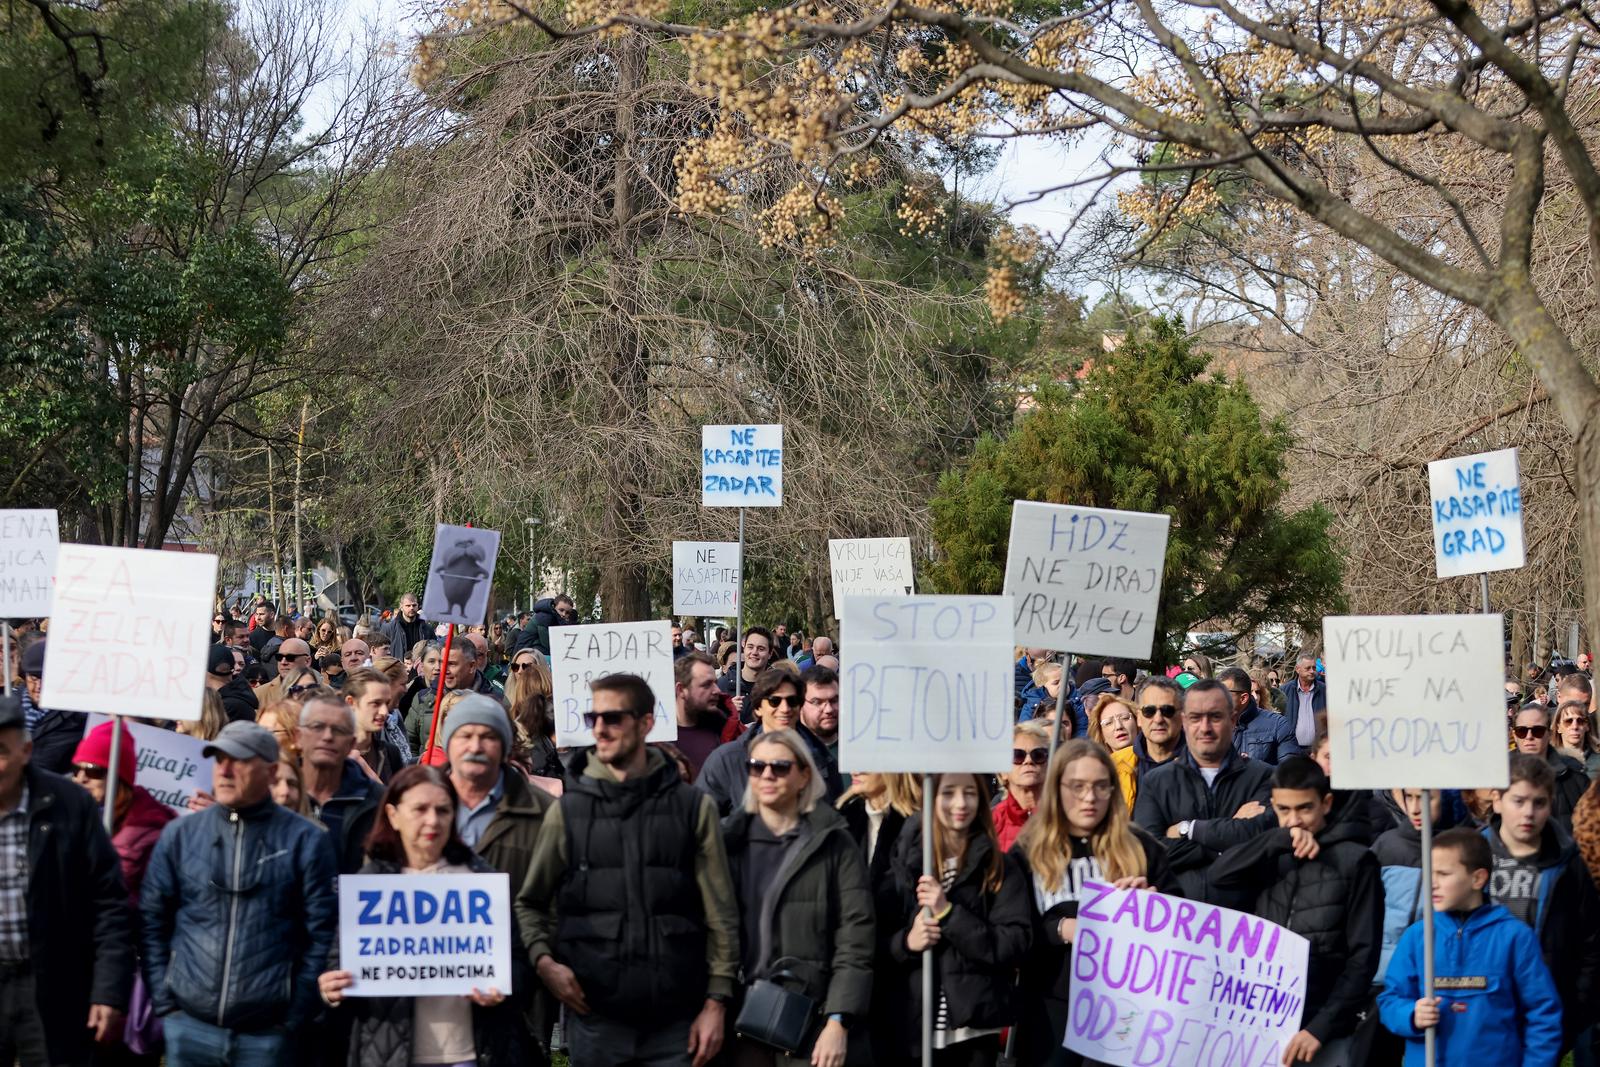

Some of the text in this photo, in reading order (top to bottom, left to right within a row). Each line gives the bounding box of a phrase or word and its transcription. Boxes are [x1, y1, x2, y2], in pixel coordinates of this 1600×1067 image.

[731, 428, 756, 446] NE
[704, 448, 780, 467] KASAPITE
[705, 475, 775, 497] ZADAR
[1456, 462, 1487, 491] NE
[1443, 526, 1505, 556] GRAD
[696, 549, 717, 564] NE
[60, 554, 136, 606] ZA
[678, 568, 738, 584] KASAPITE
[835, 565, 904, 584] NIJE VAŠA
[1021, 556, 1156, 594] NE DIRAJ
[681, 588, 737, 610] ZADAR!
[64, 609, 195, 656] ZELENI
[872, 601, 997, 641] STOP
[562, 630, 671, 661] ZADAR
[56, 648, 193, 701] ZADAR
[847, 662, 1008, 743] BETONU
[1347, 676, 1465, 706] NIJE NA
[1344, 716, 1482, 760] PRODAJU
[175, 757, 198, 781] je
[358, 890, 494, 925] ZADAR
[1078, 881, 1280, 962] ZADRANI
[359, 936, 493, 956] ZADRANIMA!
[361, 964, 495, 980] NE POJEDINCIMA
[1075, 928, 1207, 1005] BUDITE
[1073, 987, 1118, 1041] OD
